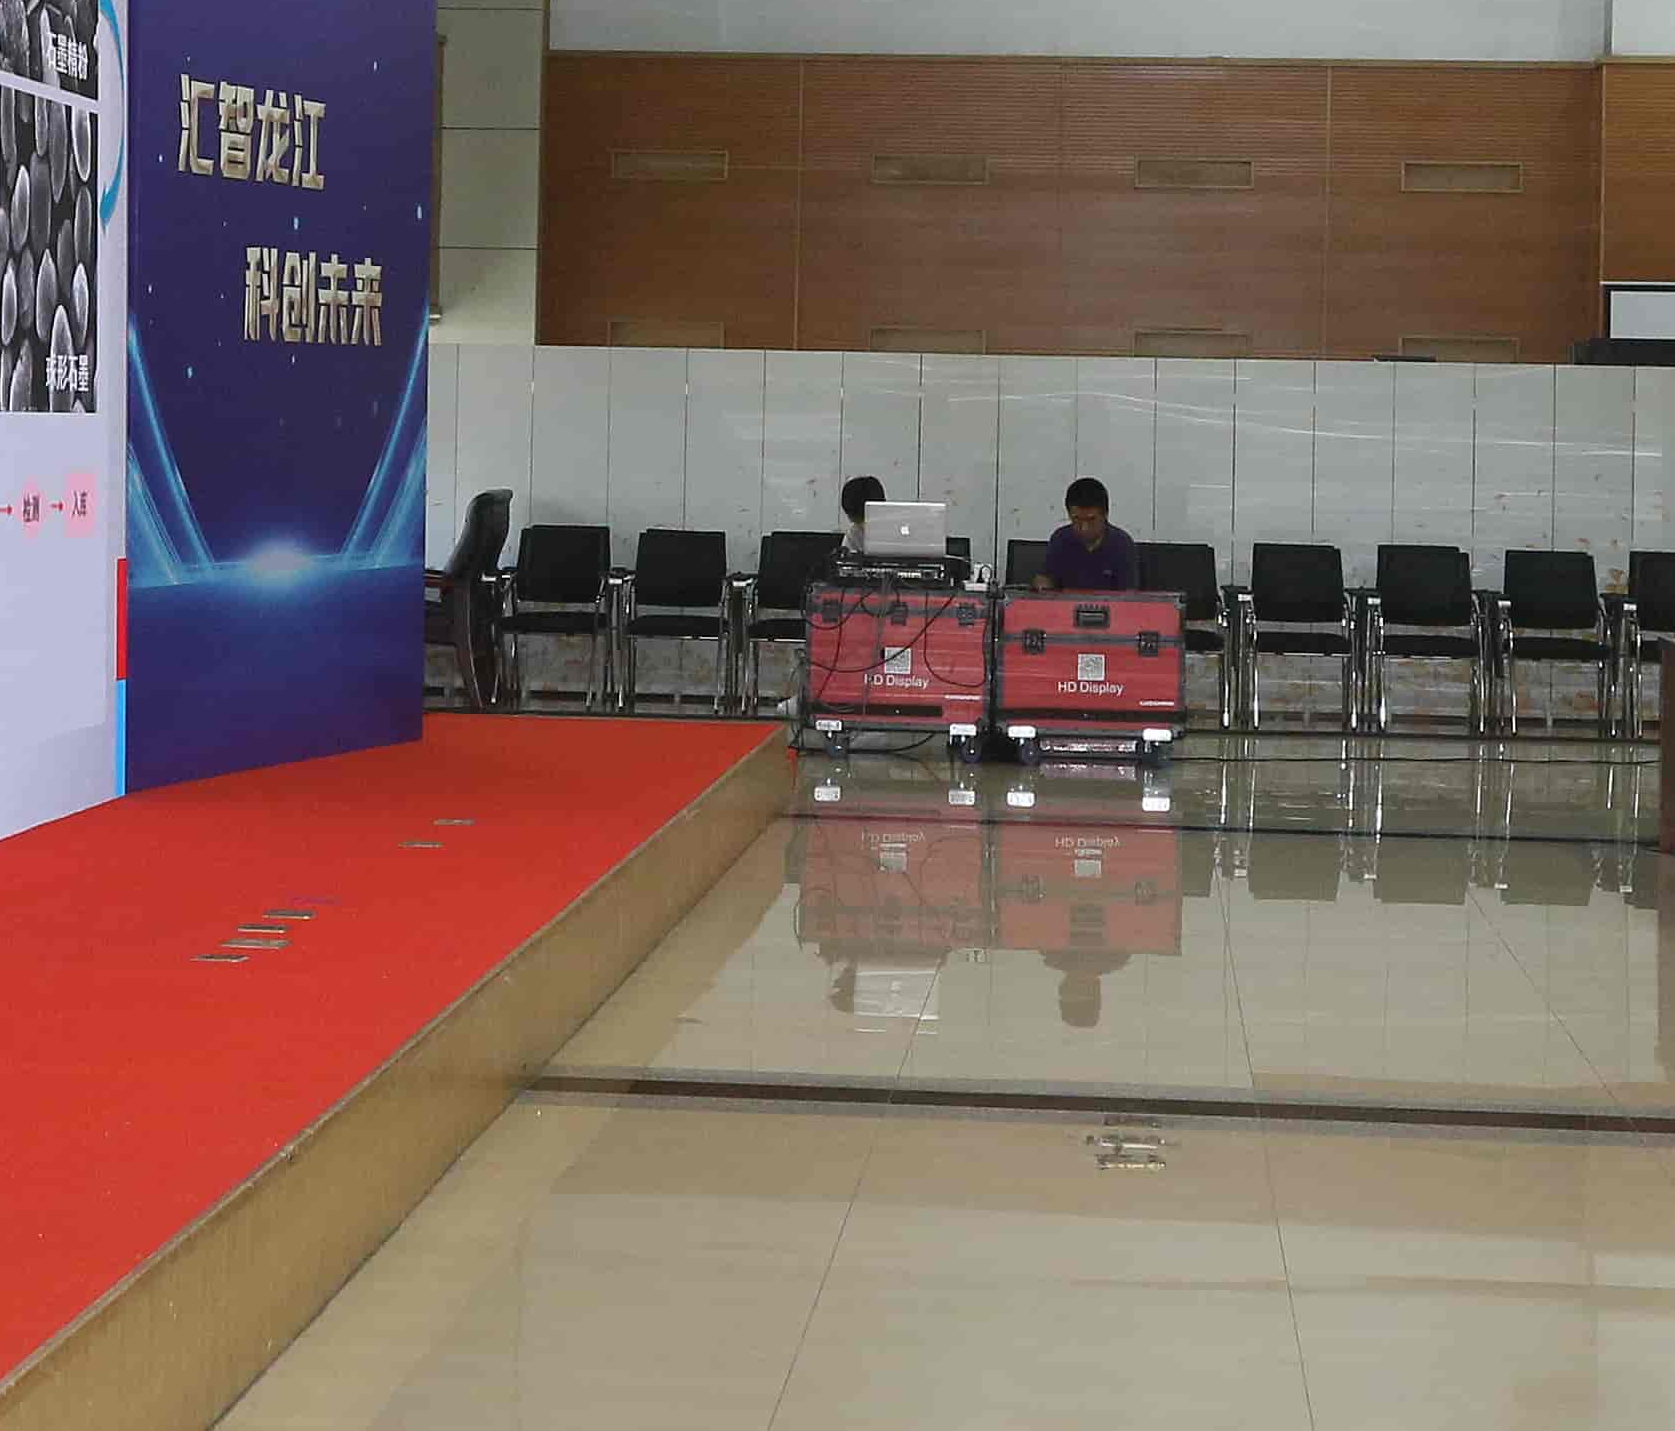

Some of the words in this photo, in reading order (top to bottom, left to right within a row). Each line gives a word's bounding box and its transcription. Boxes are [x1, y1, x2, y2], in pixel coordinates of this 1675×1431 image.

[178, 73, 327, 190] 汇智龙江
[243, 246, 383, 347] 科创未来
[46, 354, 89, 392] 球形石墨
[886, 674, 931, 689] Display
[1057, 681, 1077, 693] HD
[1079, 681, 1124, 696] Display
